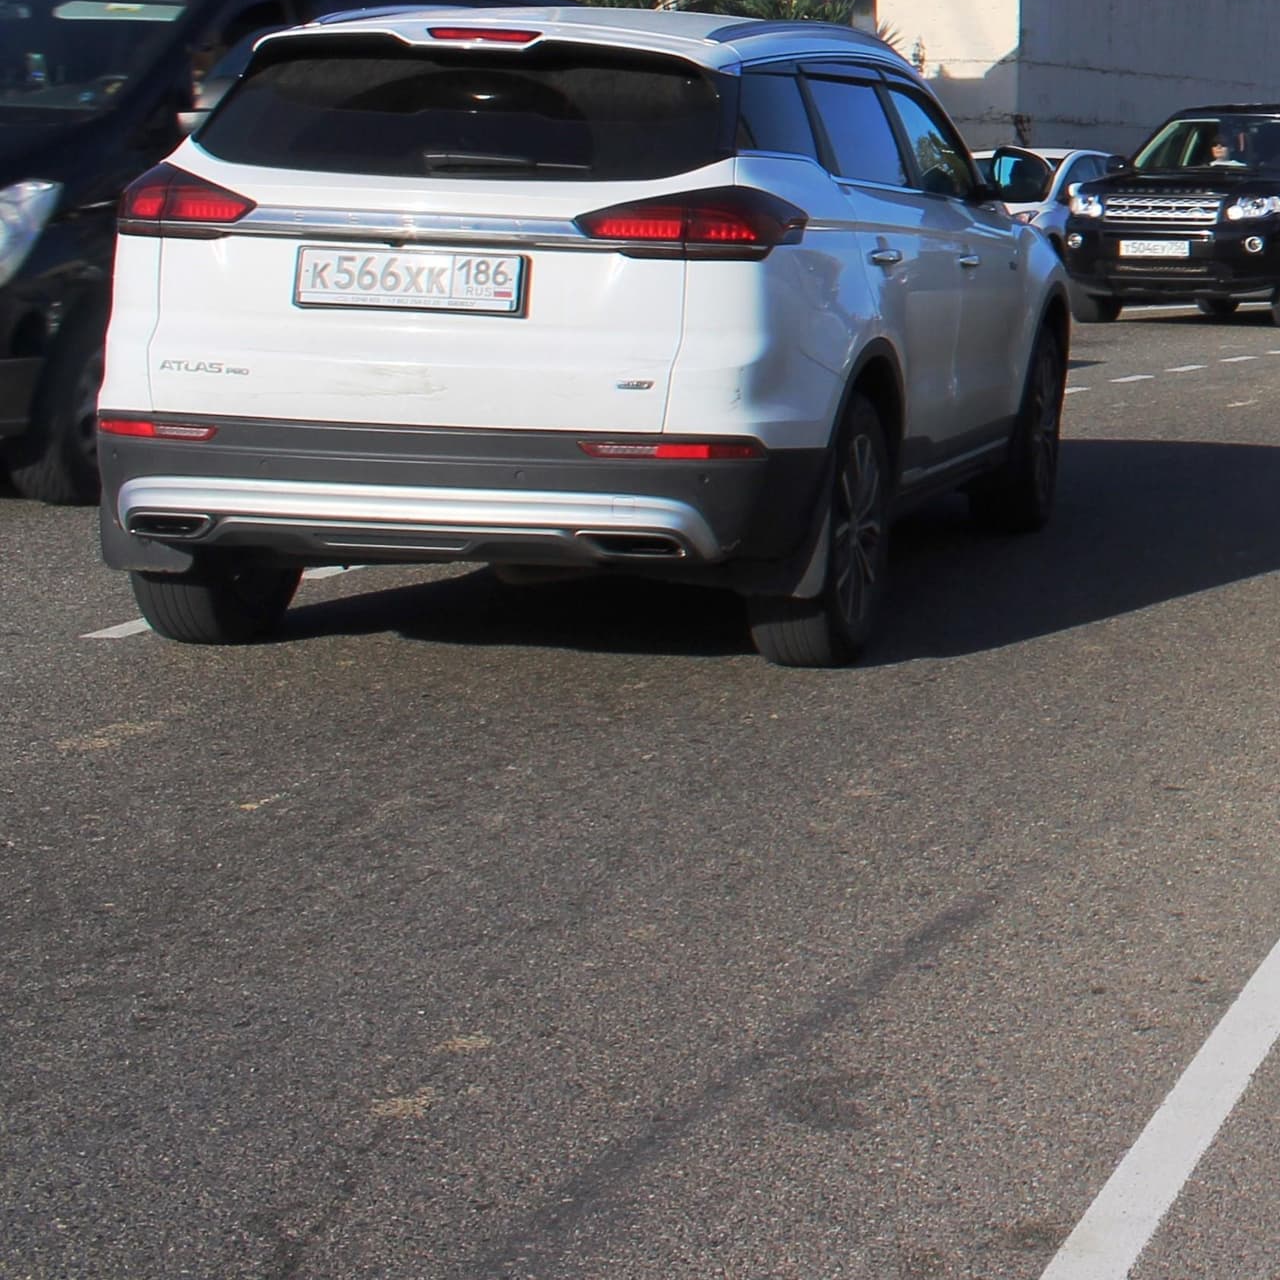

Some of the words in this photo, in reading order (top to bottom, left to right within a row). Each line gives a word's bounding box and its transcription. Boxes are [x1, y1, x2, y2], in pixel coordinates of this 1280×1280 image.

[457, 259, 508, 287] 186
[465, 286, 493, 297] RUS
[160, 359, 225, 374] ATLAS
